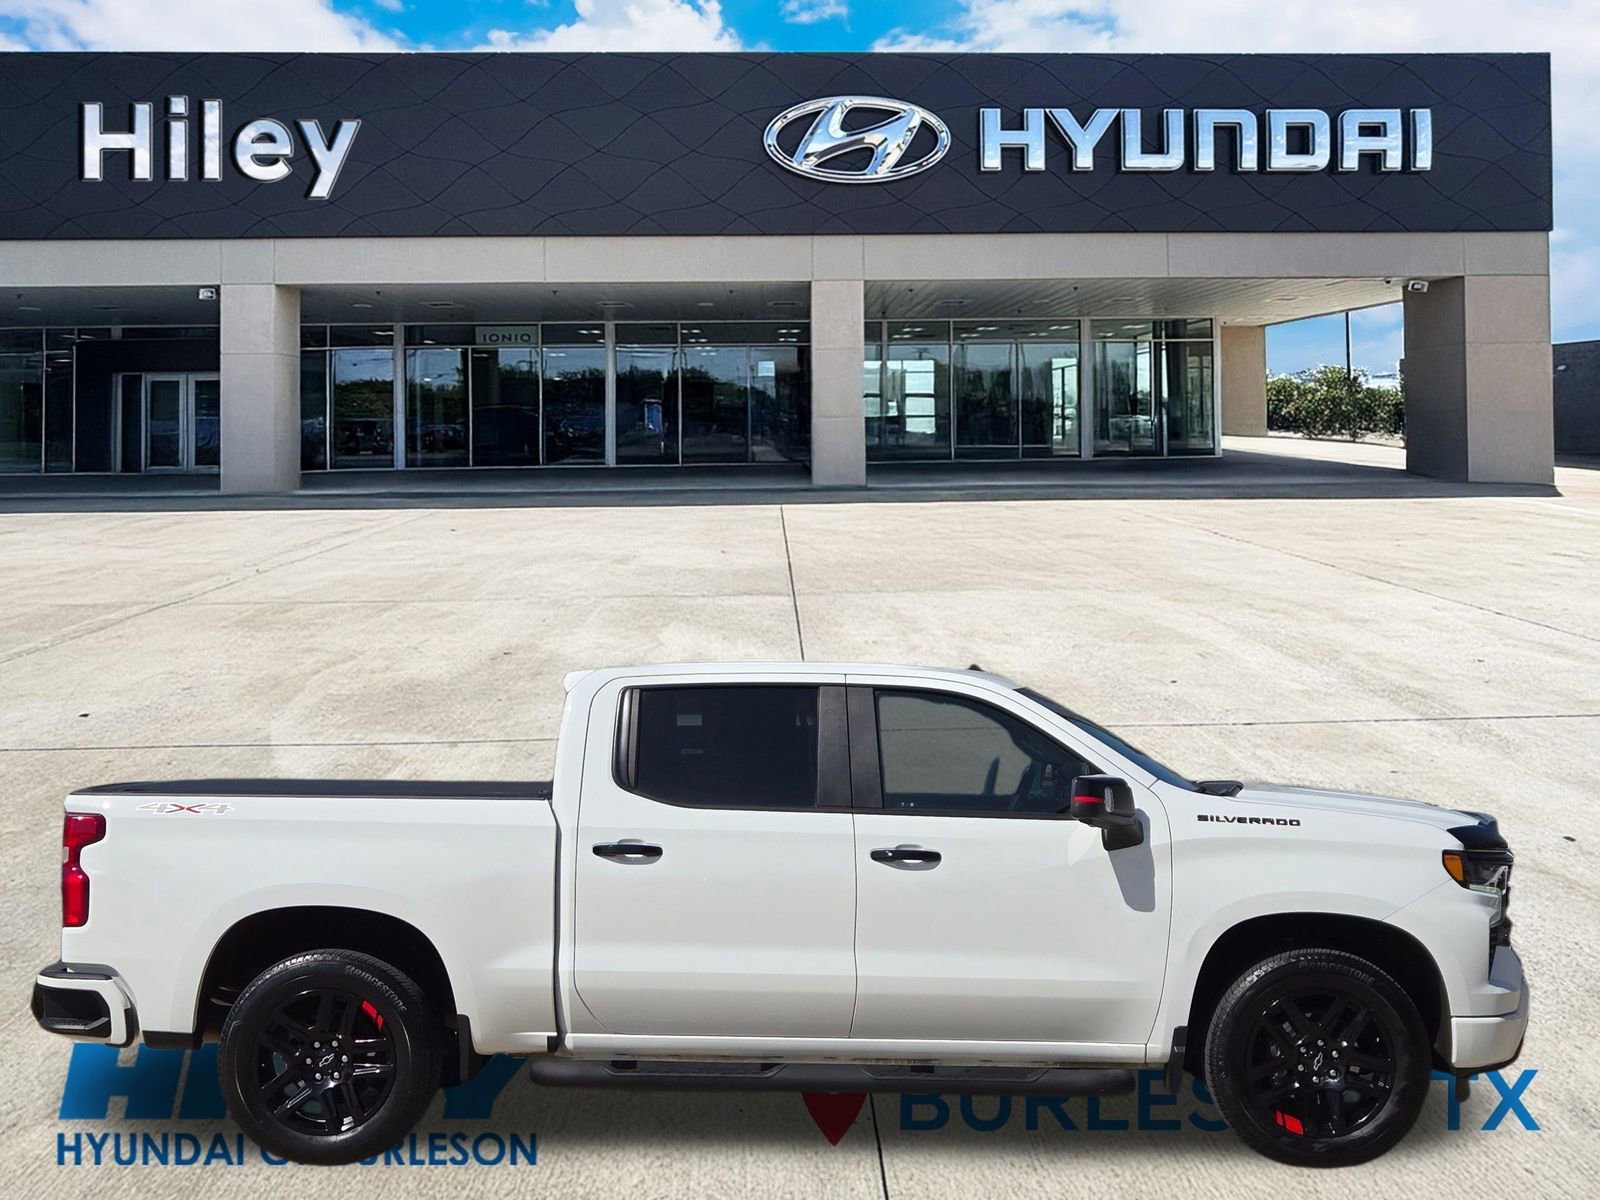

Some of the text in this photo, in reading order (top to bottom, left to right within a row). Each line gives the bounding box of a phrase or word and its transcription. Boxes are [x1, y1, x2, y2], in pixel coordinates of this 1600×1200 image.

[80, 95, 361, 199] Hiley
[980, 108, 1432, 171] HYUNDAI
[483, 333, 532, 343] IONIQ
[1197, 814, 1301, 827] SILVERADO
